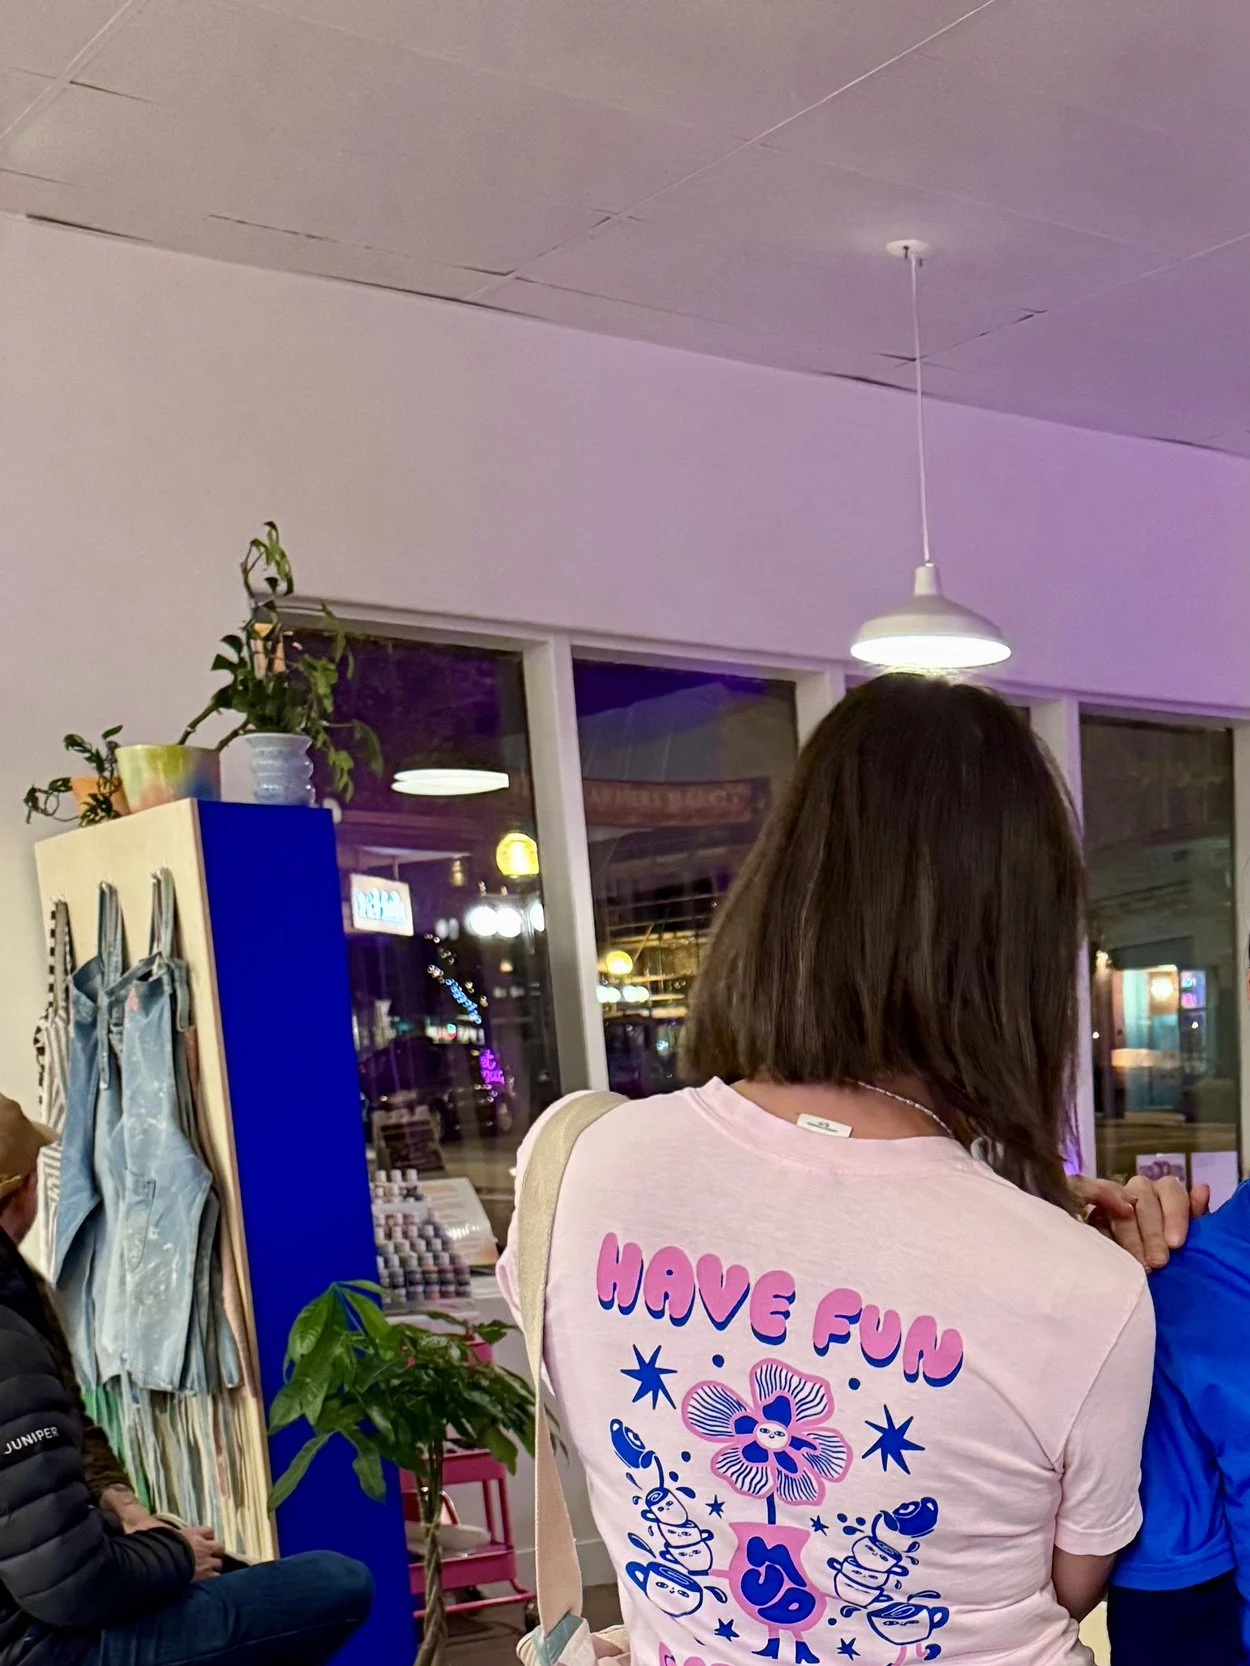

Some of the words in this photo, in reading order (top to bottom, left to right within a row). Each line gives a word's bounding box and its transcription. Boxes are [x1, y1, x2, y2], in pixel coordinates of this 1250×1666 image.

[596, 1231, 796, 1345] HAVE
[812, 1287, 964, 1388] FUN
[3, 1426, 59, 1454] JUNIPER
